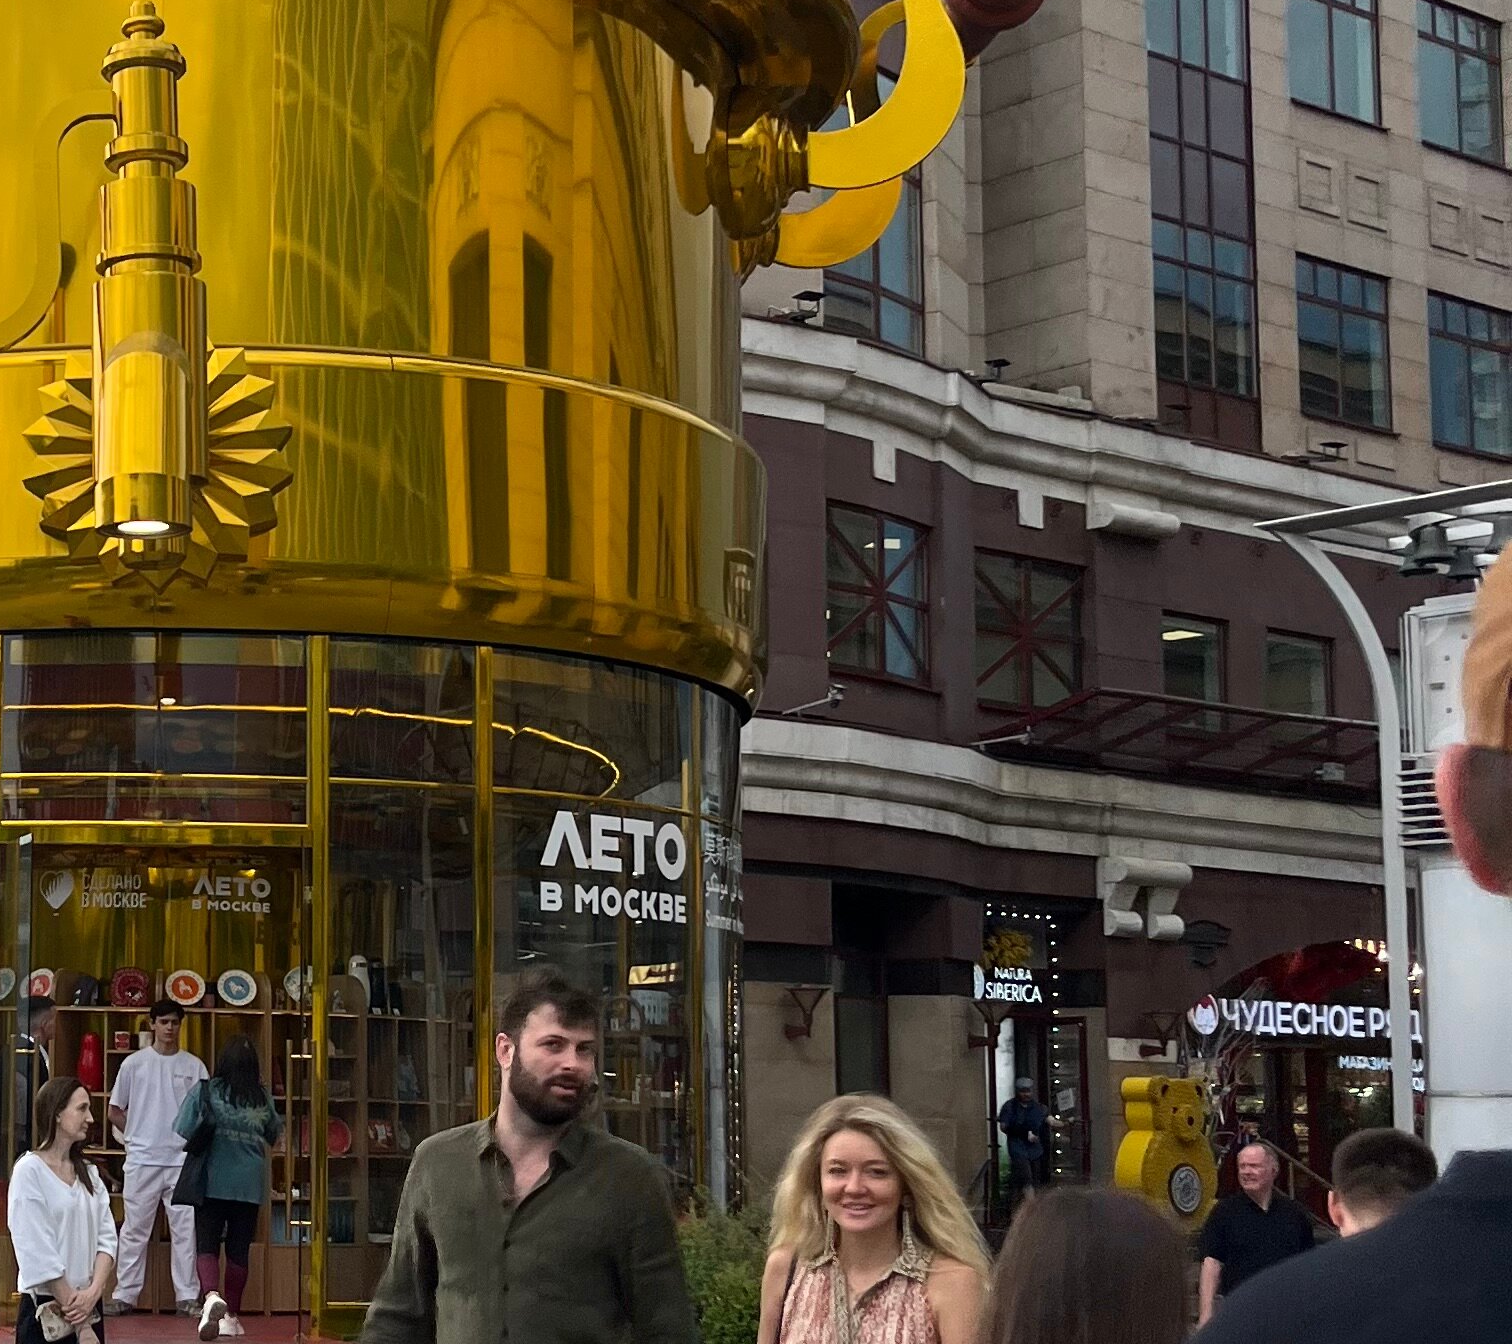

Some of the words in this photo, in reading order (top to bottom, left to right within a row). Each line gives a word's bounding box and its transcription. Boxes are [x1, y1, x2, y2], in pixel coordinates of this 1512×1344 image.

[540, 811, 687, 881] ЛЕТО
[82, 872, 142, 892] СДЕЛАНО
[193, 875, 271, 898] ЛЕТО
[81, 892, 89, 908] В
[93, 892, 147, 908] МОСКВЕ
[192, 899, 202, 910] В
[207, 901, 271, 914] МОСКВЕ
[540, 881, 562, 911] В
[575, 884, 687, 924] МОСКВЕ
[994, 966, 1033, 981] NATURA
[986, 982, 1043, 1003] SIBERICA
[1221, 998, 1366, 1038] ЧУДЕСНОЕ
[1369, 1007, 1423, 1044] РД
